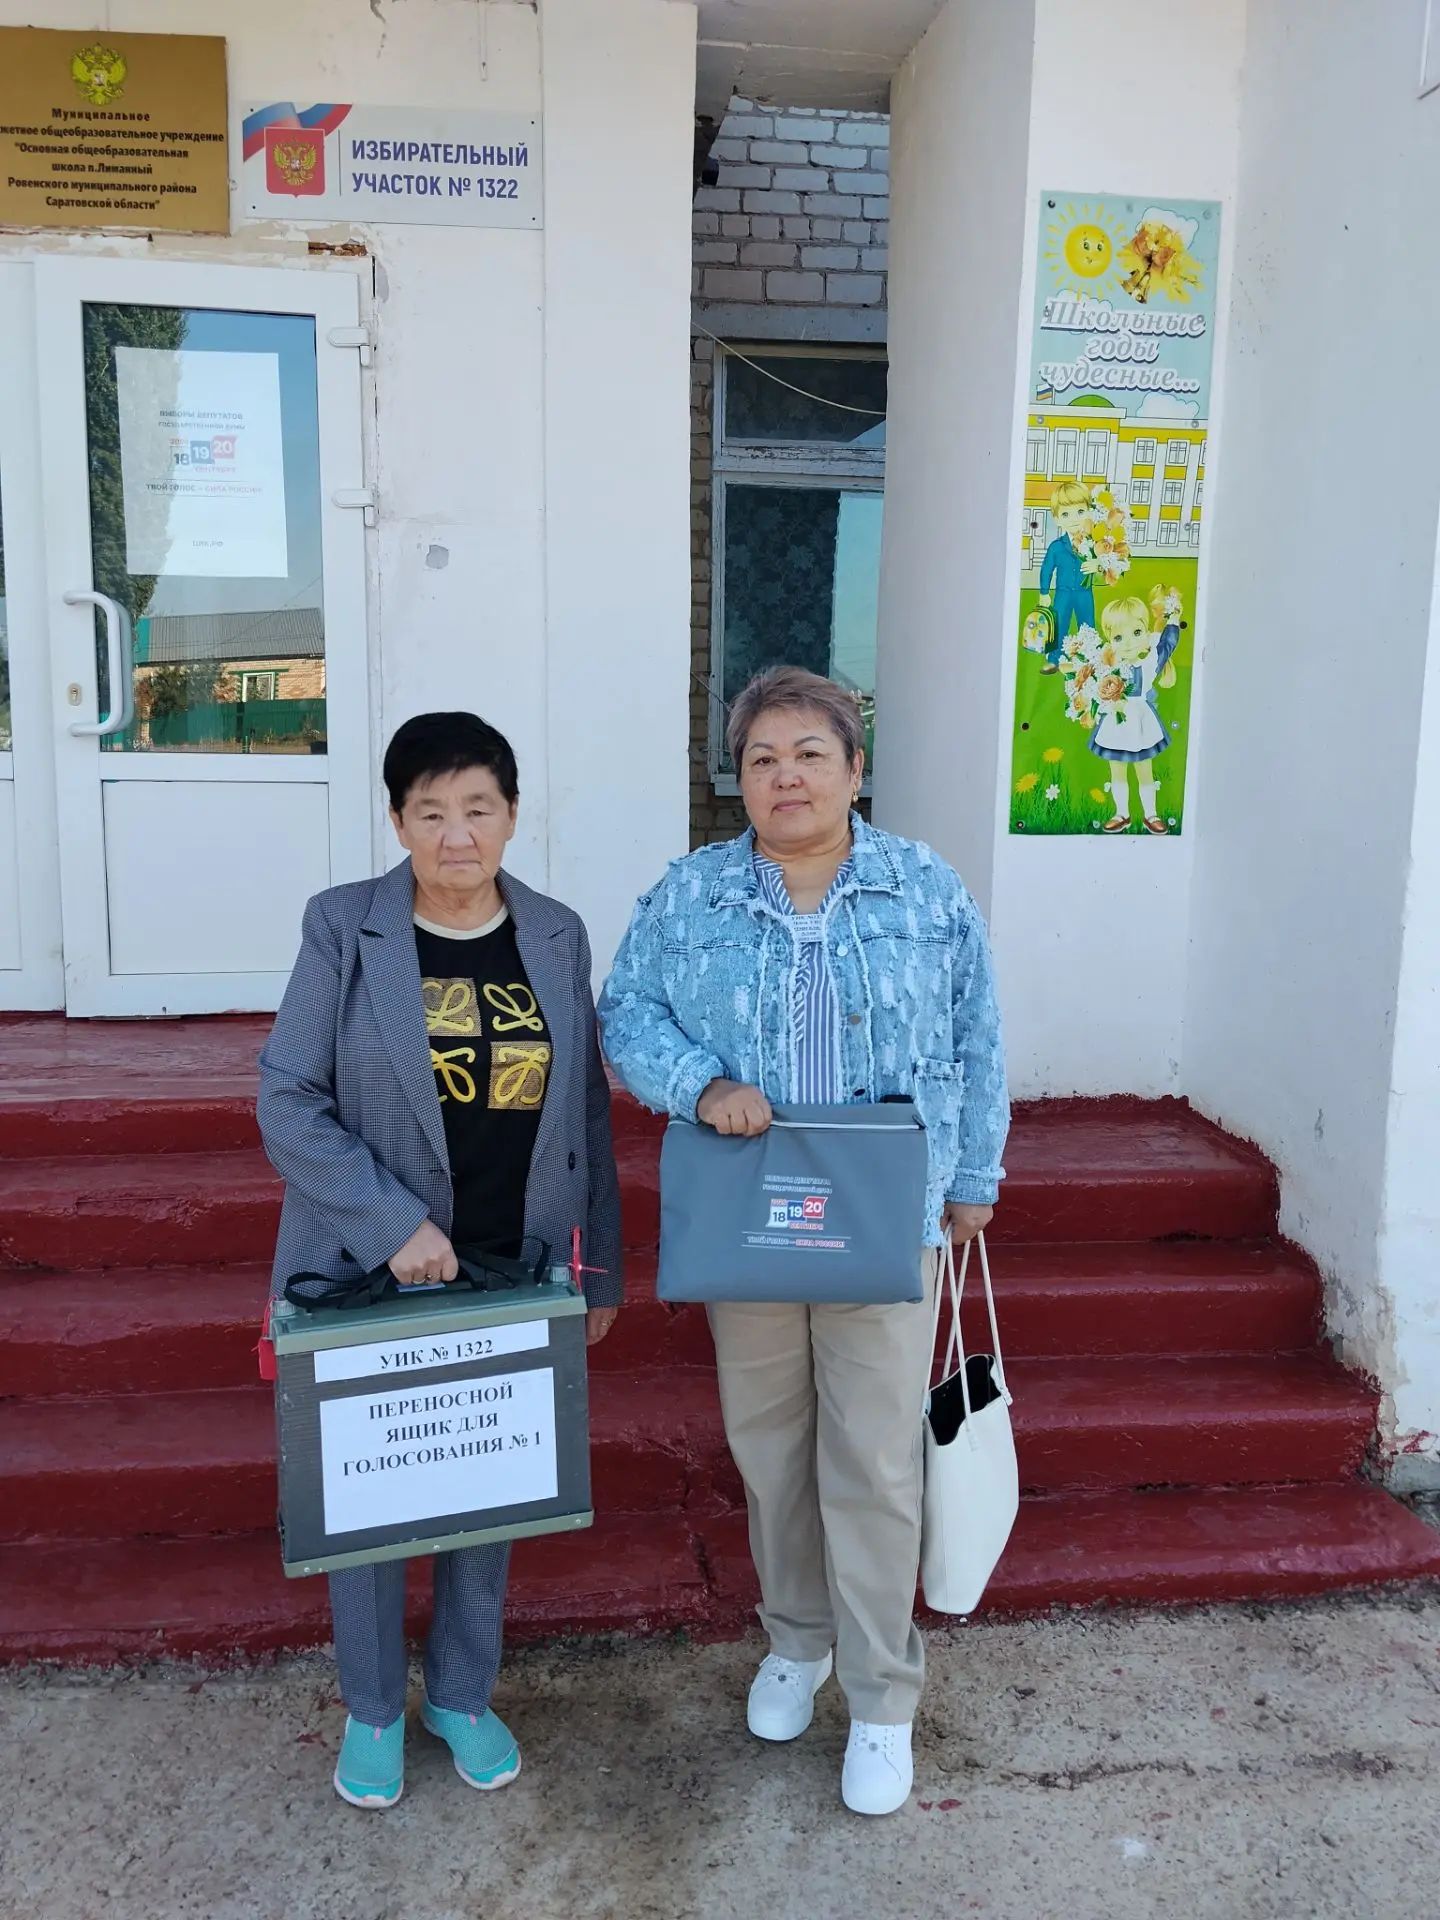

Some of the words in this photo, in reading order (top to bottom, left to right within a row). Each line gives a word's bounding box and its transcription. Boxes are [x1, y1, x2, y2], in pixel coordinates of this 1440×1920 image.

[52, 108, 150, 121] Муниципальное
[41, 125, 158, 139] общеобразовательное
[160, 132, 224, 143] учреждение
[15, 142, 69, 154] "Основная
[72, 144, 189, 158] общеобразовательная
[352, 140, 528, 167] ИЗБИРАТЕЛЬНЫЙ
[52, 163, 85, 172] школа
[88, 163, 153, 174] п.Лиманный
[8, 177, 68, 189] Ровенского
[71, 181, 158, 192] муниципального
[160, 182, 197, 195] района
[352, 173, 442, 196] УЧАСТОК
[448, 177, 471, 196] №
[477, 178, 519, 199] 1322
[46, 196, 112, 209] Саратовской
[114, 198, 160, 210] области"
[1045, 300, 1203, 332] Школьные
[1086, 335, 1158, 356] годы
[1042, 358, 1197, 388] чудесные...
[193, 446, 210, 460] 19
[214, 440, 233, 454] 20
[174, 453, 190, 465] 18
[773, 1211, 786, 1222] 18
[789, 1206, 802, 1218] 19
[805, 1202, 822, 1213] 20
[380, 1349, 424, 1369] УИК
[429, 1346, 449, 1362] №
[456, 1339, 493, 1358] 1322
[369, 1381, 513, 1420] ПЕРЕНОСНОЙ
[386, 1419, 452, 1444] ЯЩИК
[457, 1412, 499, 1435] ДЛЯ
[343, 1437, 504, 1477] ГОЛОСОВАНИЯ
[509, 1433, 529, 1450] №
[535, 1431, 541, 1446] 1
